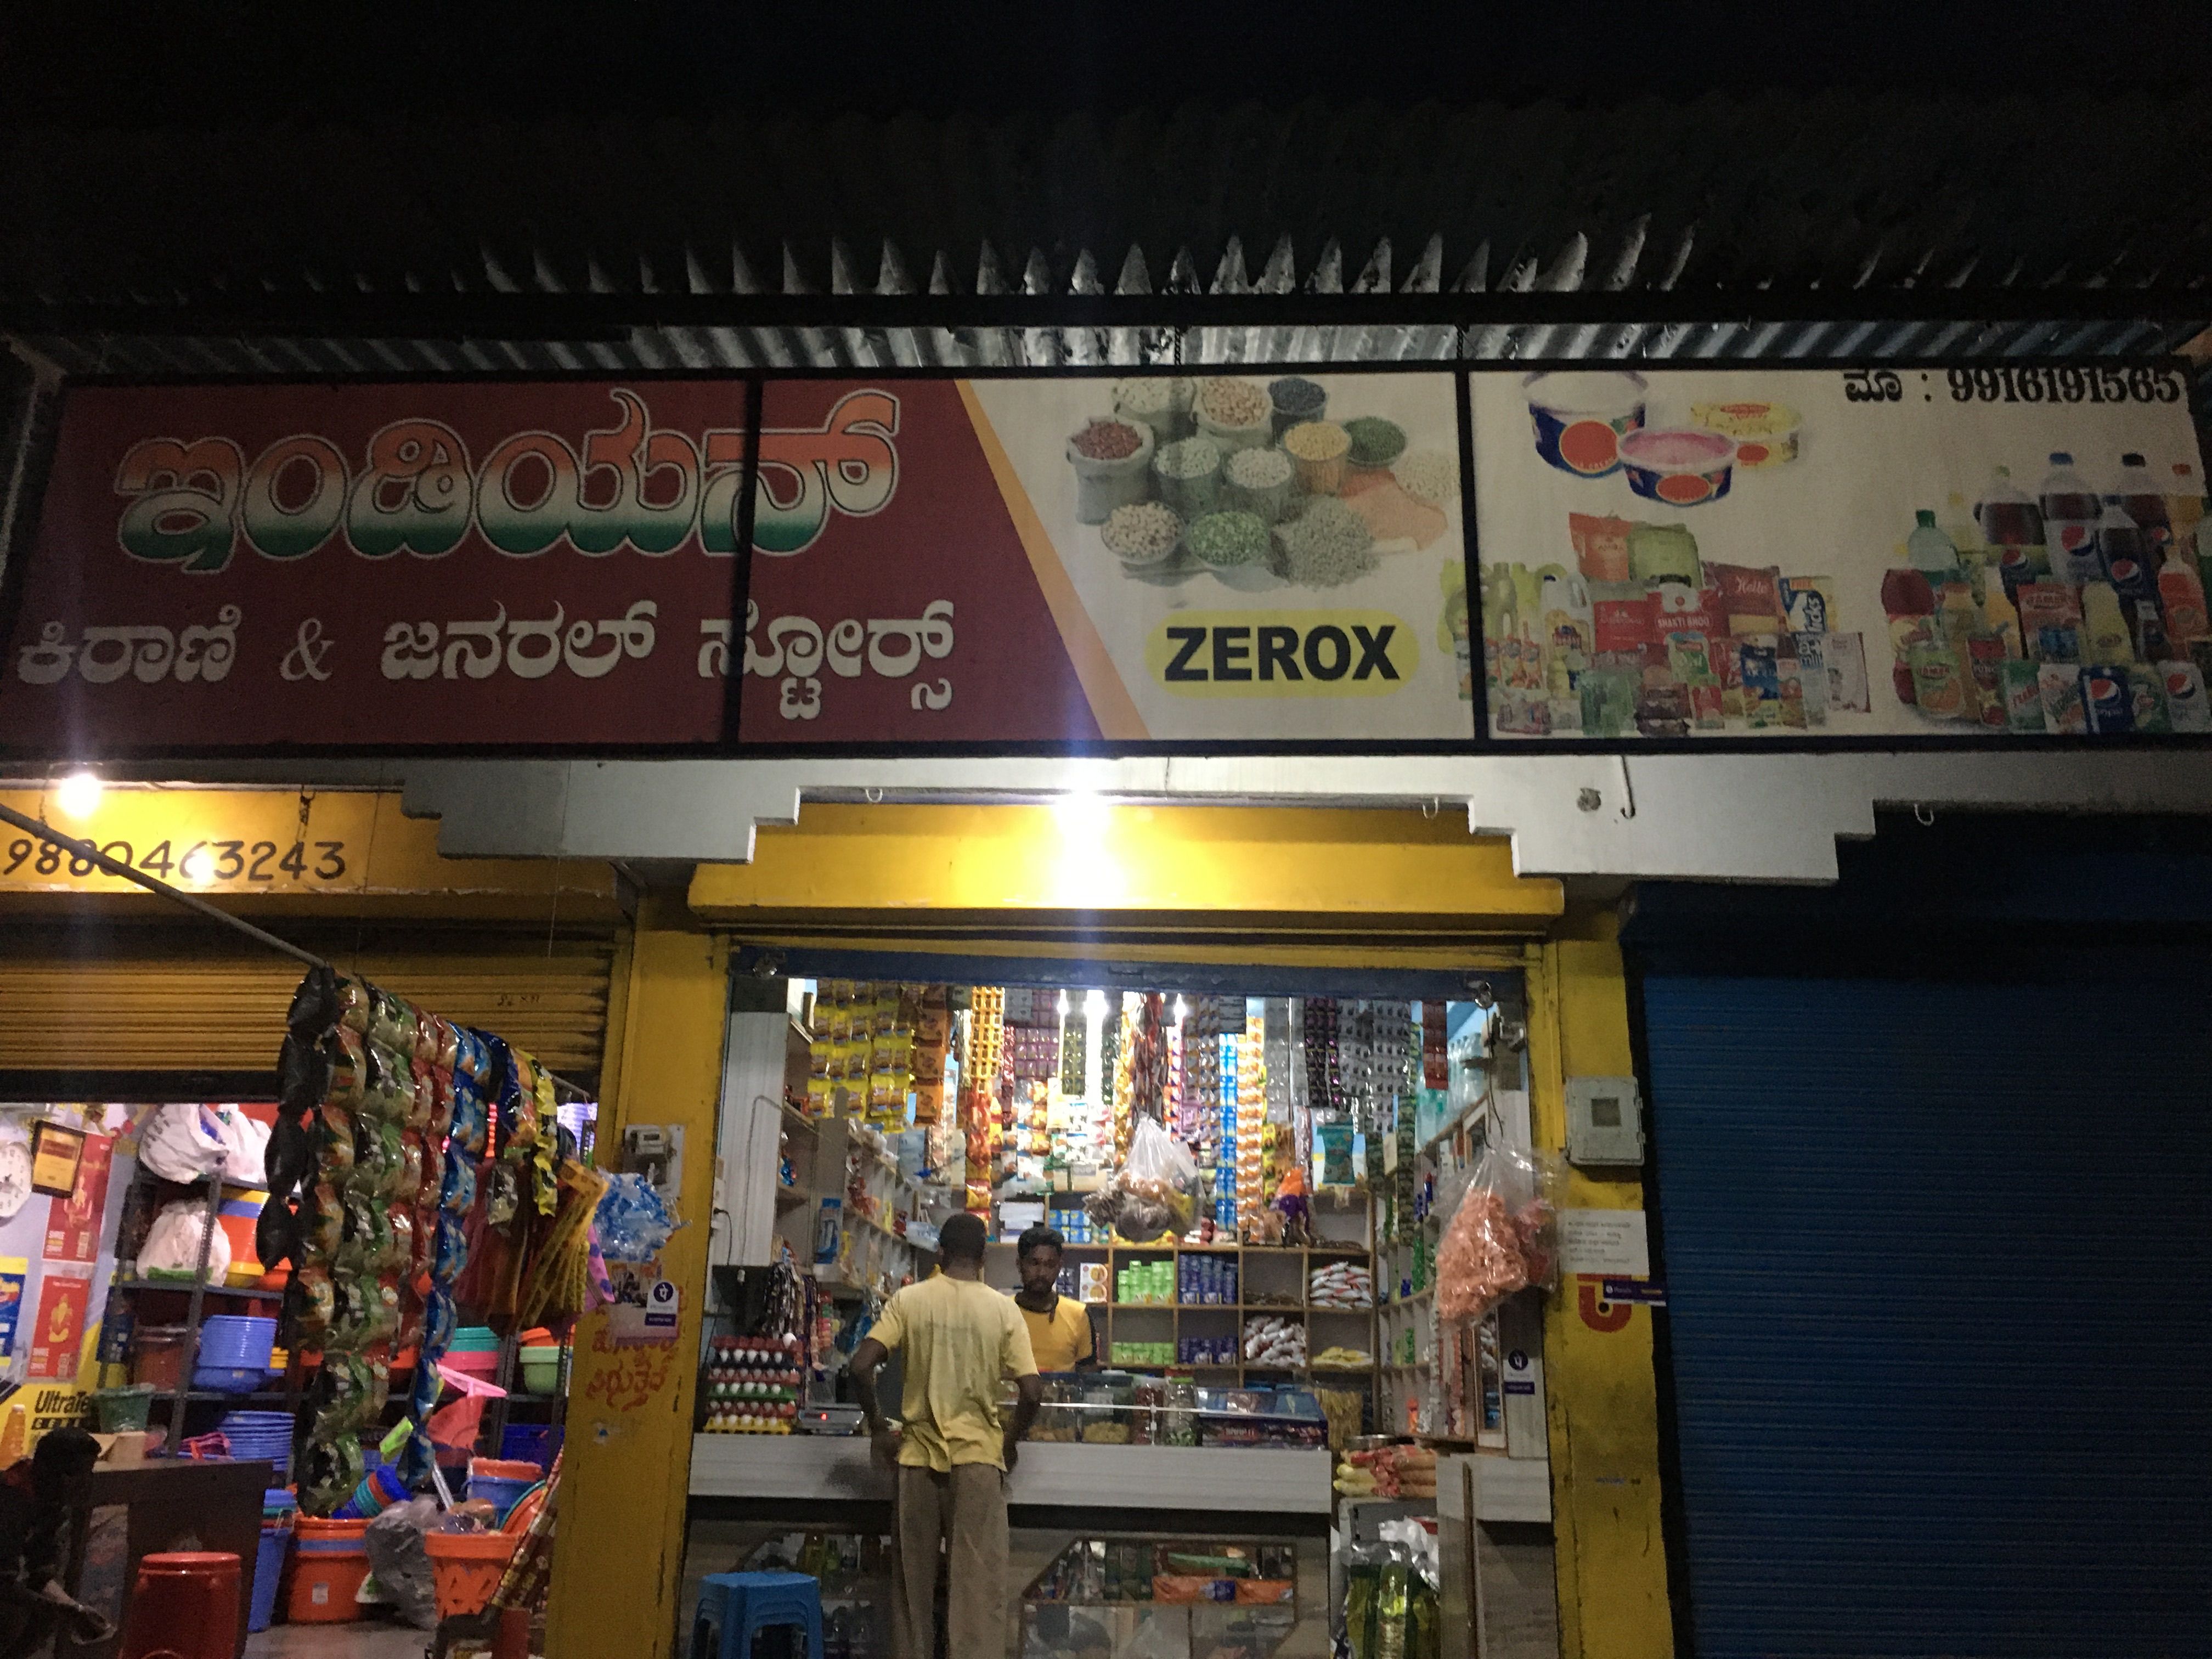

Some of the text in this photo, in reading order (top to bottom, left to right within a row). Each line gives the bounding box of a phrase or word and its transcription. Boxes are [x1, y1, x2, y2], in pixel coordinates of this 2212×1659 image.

[1948, 368, 2180, 403] 9916191565
[280, 618, 333, 681] &
[380, 599, 658, 681] ಜನರಲ್
[698, 599, 954, 720] ಸ್ಟೋರ್ಸ್
[1164, 625, 1400, 681] ZEROX
[3, 839, 346, 881] 9880463243
[35, 1390, 89, 1414] UltraTe
